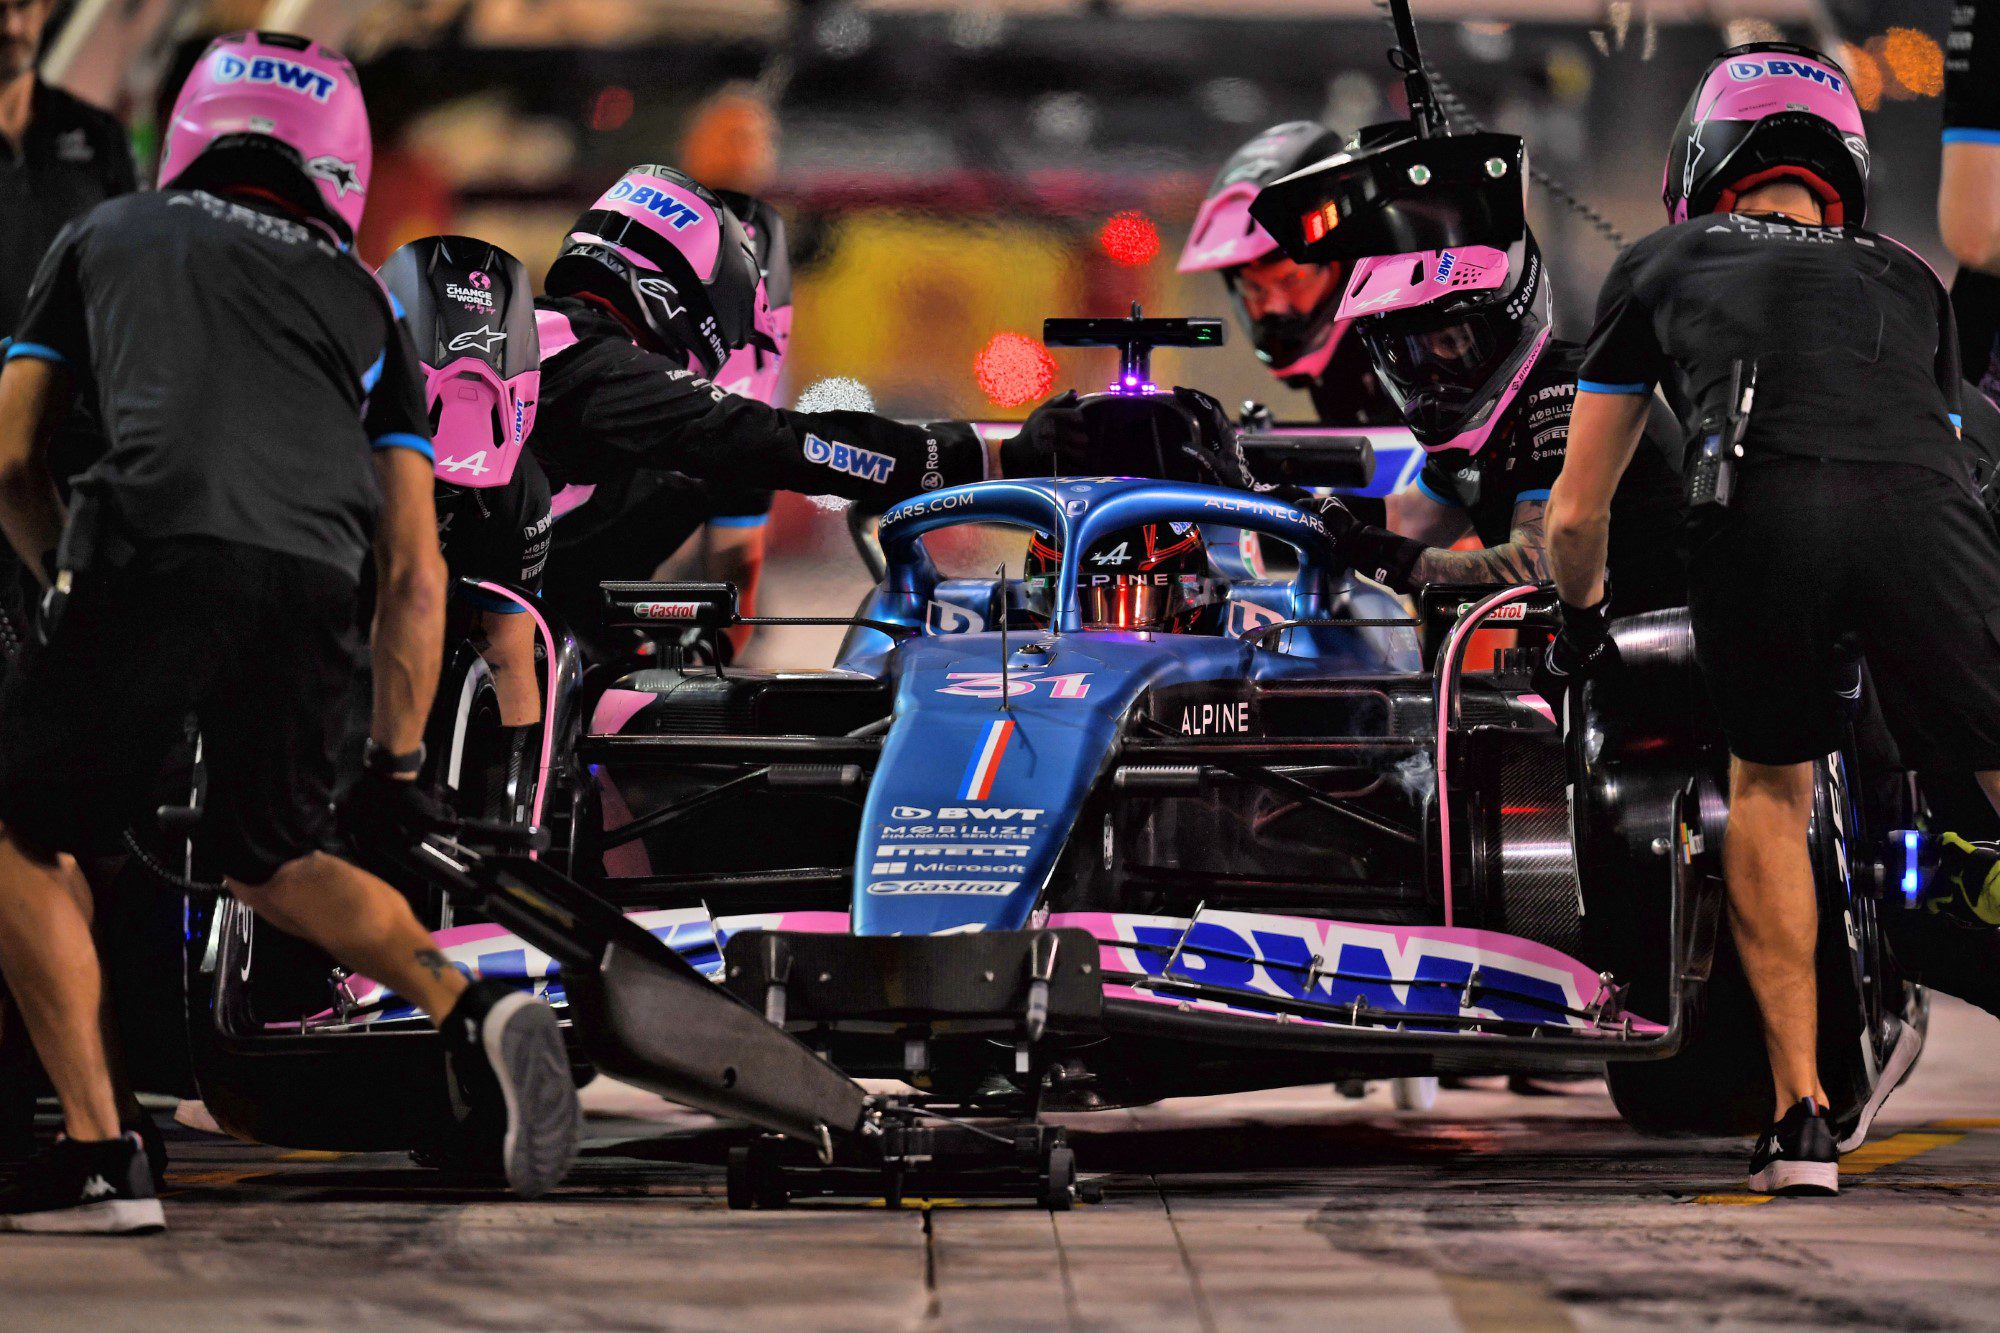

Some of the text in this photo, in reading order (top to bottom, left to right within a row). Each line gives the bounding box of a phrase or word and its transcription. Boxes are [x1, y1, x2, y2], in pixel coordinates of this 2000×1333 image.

[251, 59, 333, 99] BWT
[1767, 60, 1843, 93] BWT
[627, 185, 701, 230] BWT
[1438, 251, 1456, 278] BWT
[1522, 253, 1540, 304] shamir
[446, 286, 492, 301] CHANGE
[456, 294, 493, 307] WORLD
[709, 333, 727, 365] sha
[1518, 341, 1543, 382] BINANCE
[1538, 383, 1575, 401] BWT
[514, 398, 526, 435] BWT
[1533, 425, 1570, 448] PIREL
[830, 441, 895, 482] BWT
[1542, 448, 1567, 459] BINAN
[536, 506, 552, 534] BW
[649, 603, 695, 618] Castrol
[1489, 604, 1522, 619] strol
[934, 671, 1095, 699] 31
[1181, 701, 1250, 736] ALPINE
[936, 806, 1046, 821] BWT
[876, 843, 1031, 858] PIRELLI
[913, 862, 1027, 874] Microsoft
[902, 881, 1006, 894] Castrol
[1131, 920, 1574, 1036] BWT
